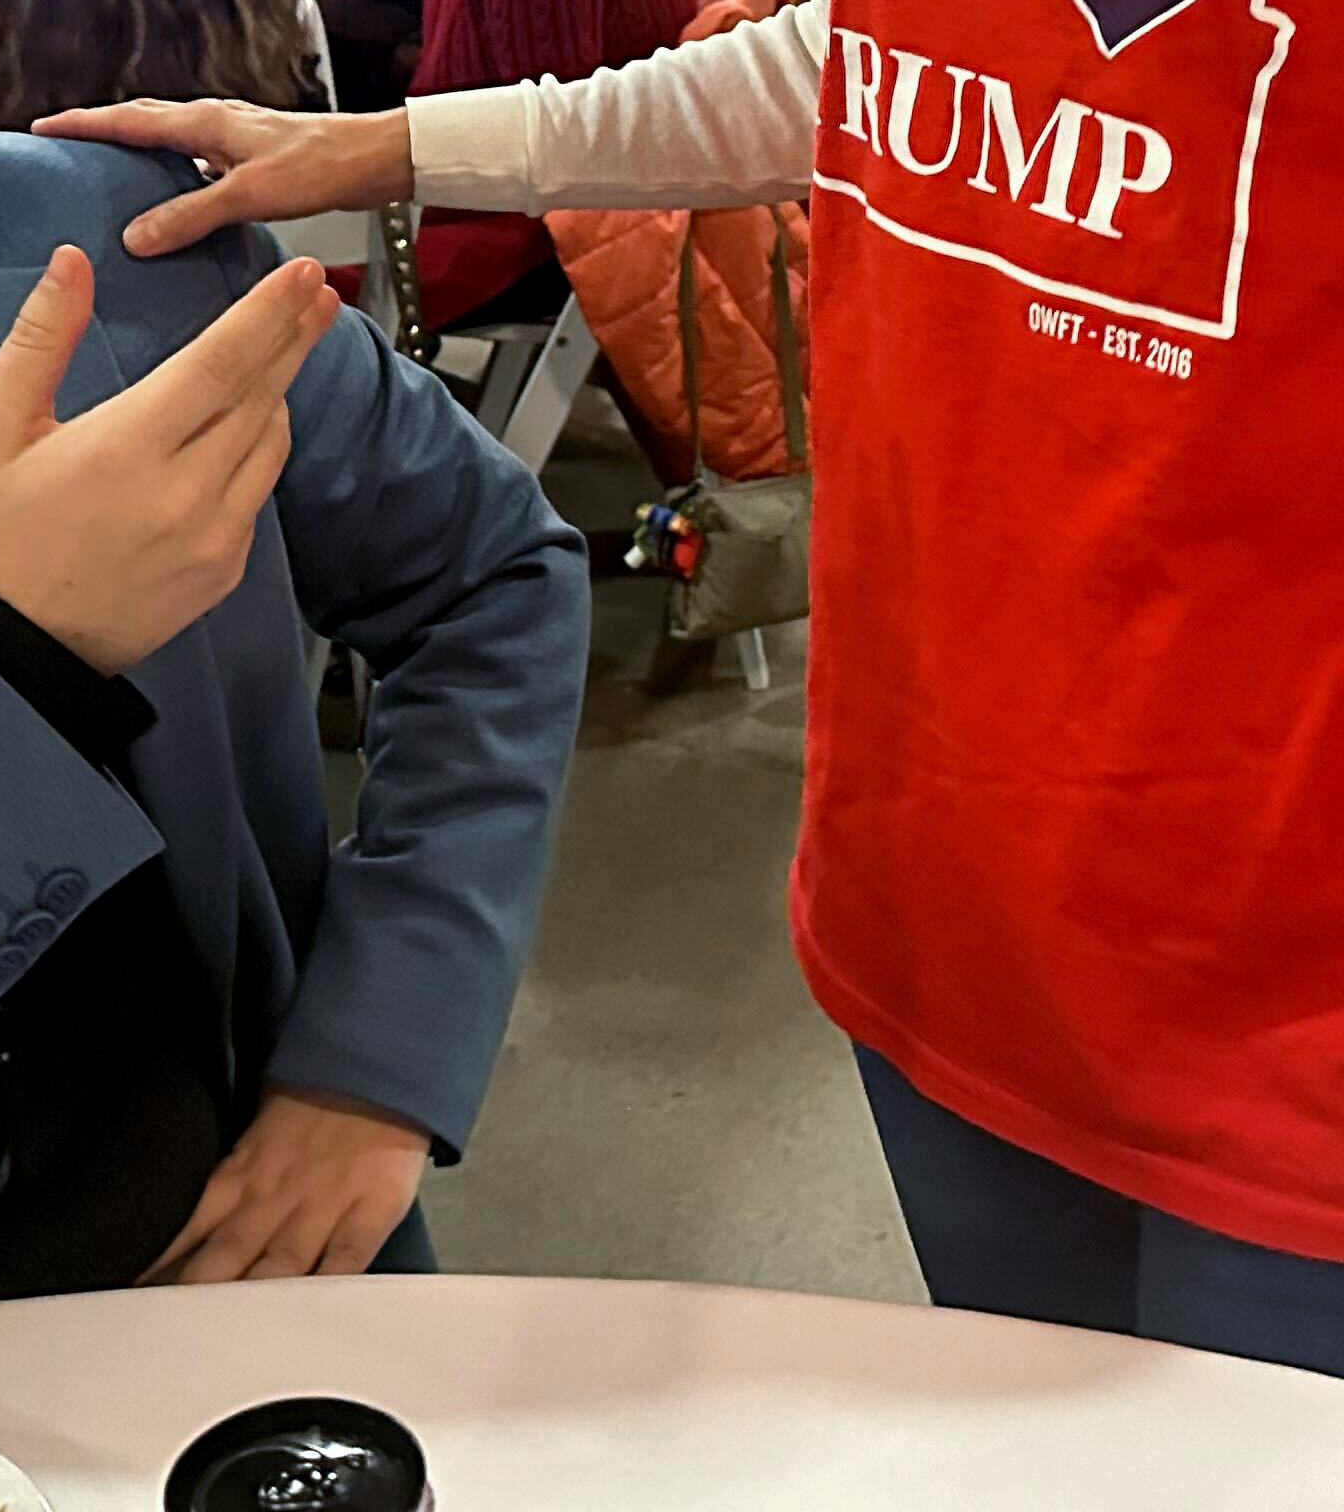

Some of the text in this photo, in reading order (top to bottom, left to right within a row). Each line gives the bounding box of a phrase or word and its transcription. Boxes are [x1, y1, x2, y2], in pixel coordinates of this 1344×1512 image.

[818, 27, 1174, 240] RUMP
[1028, 302, 1085, 345] OWFT
[1102, 323, 1142, 363] EST.
[1145, 337, 1194, 379] 2016
